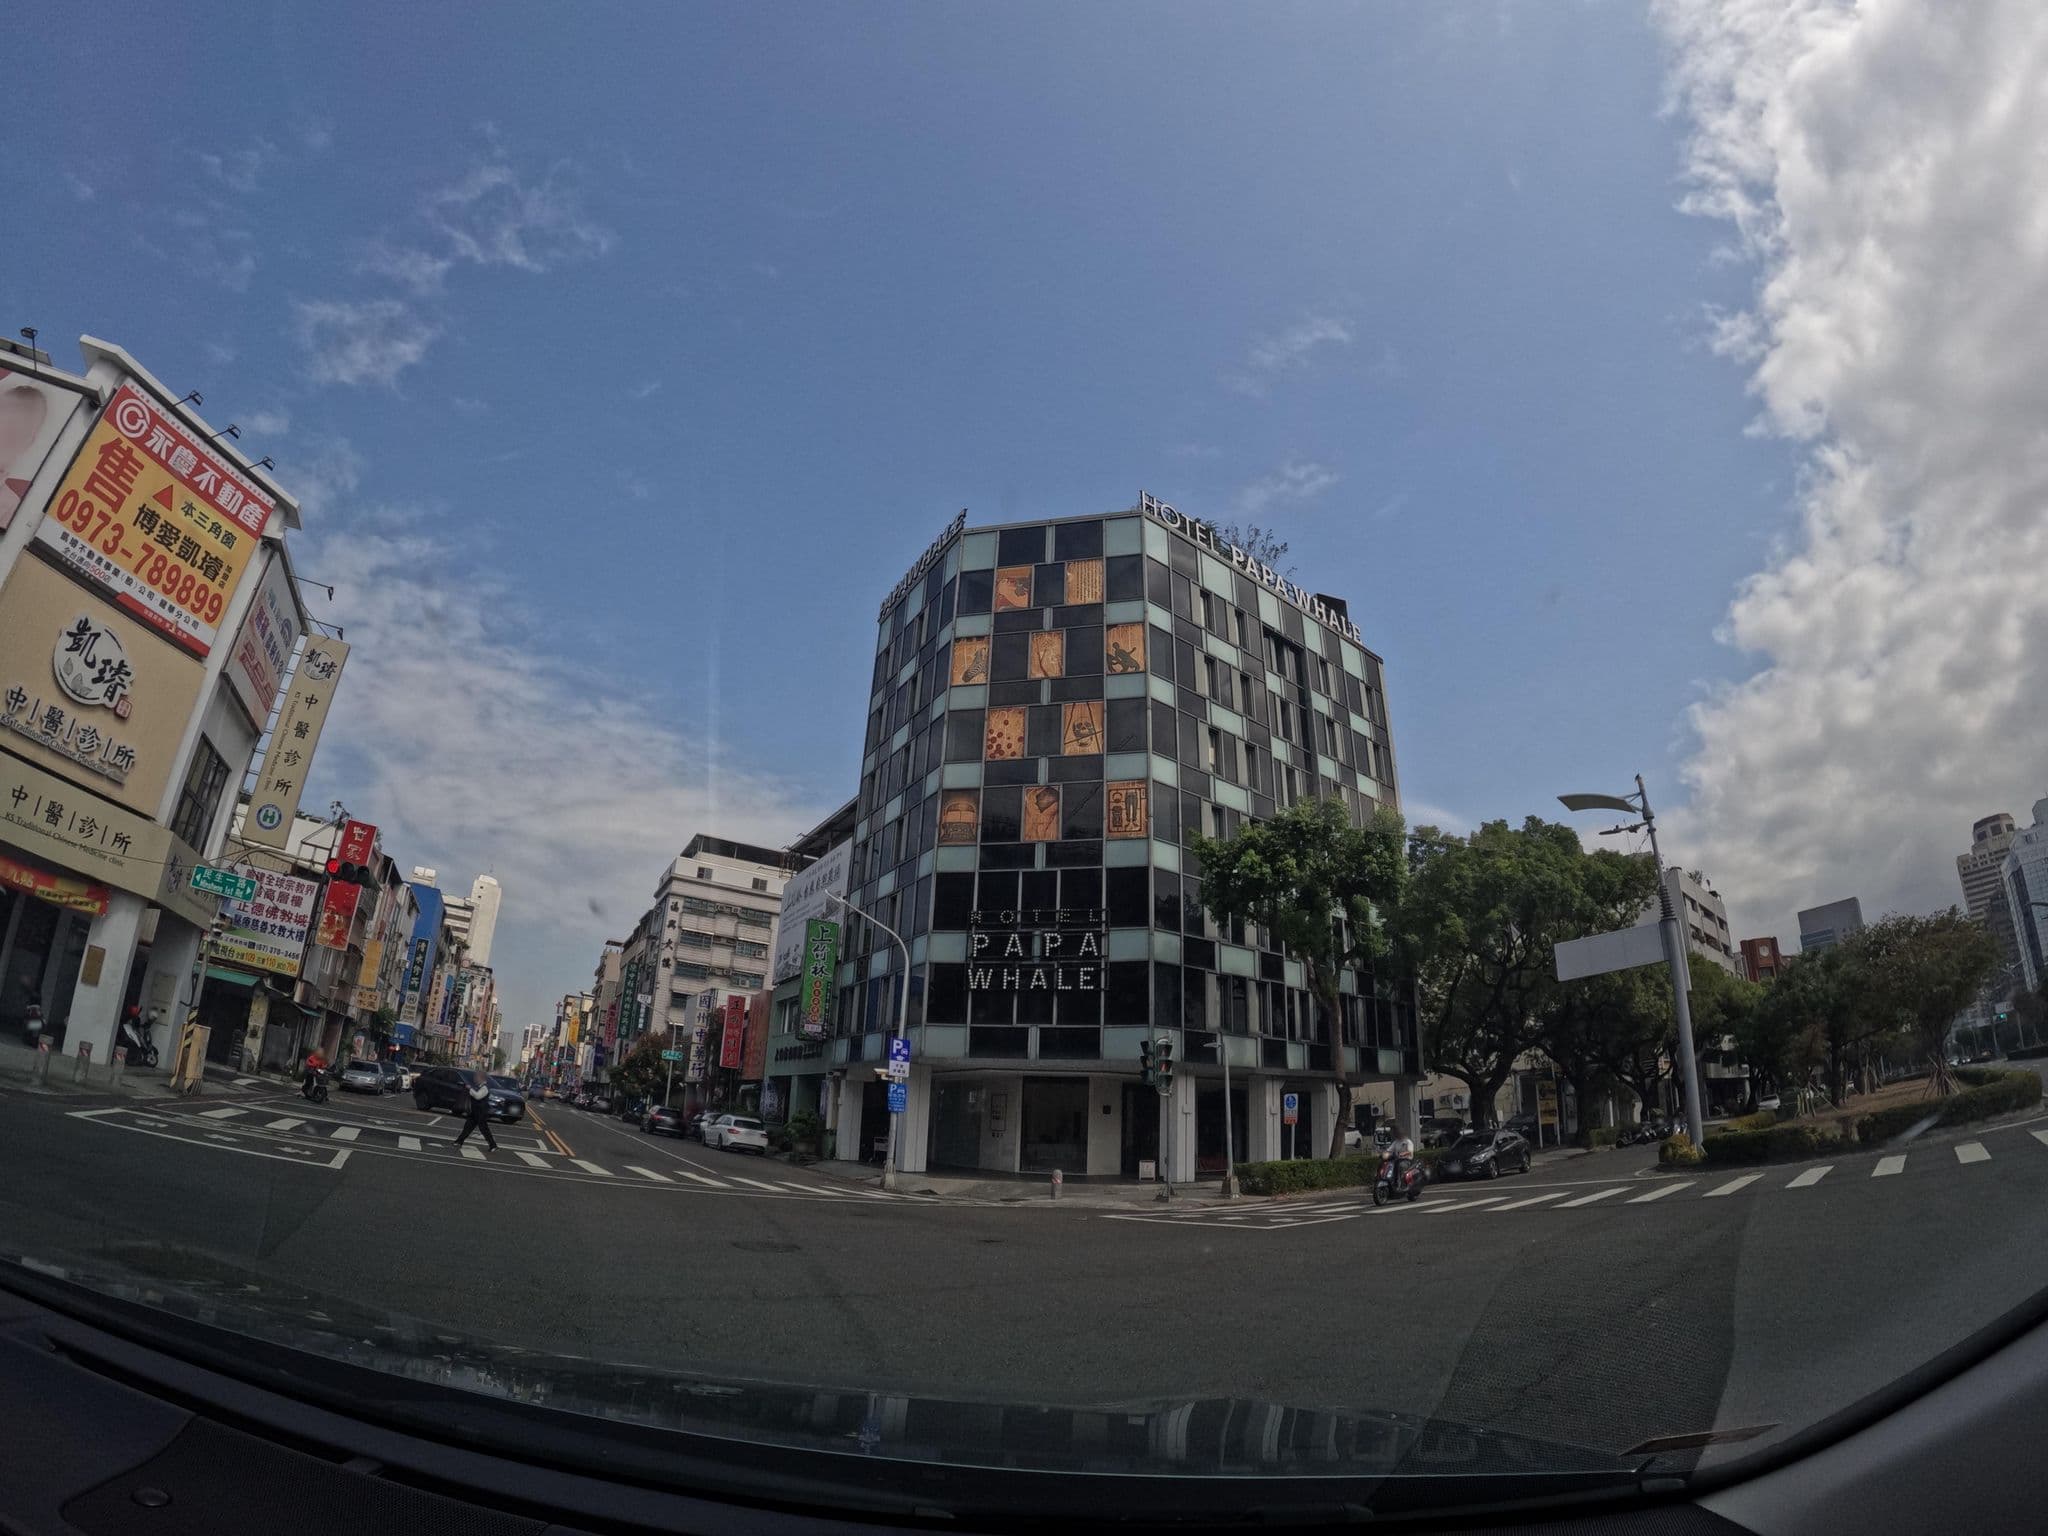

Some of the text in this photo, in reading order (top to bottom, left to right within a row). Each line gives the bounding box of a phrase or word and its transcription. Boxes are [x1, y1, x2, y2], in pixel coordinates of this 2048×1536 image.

[84, 437, 145, 514] 售
[144, 427, 265, 531] 永慶不動產
[56, 489, 224, 624] 0973-789899
[132, 503, 224, 583] 博愛凱璿
[1140, 490, 1364, 644] HOTEL PAPA WHALE
[64, 616, 134, 702] 凱璿
[305, 648, 338, 679] 凱璿
[273, 693, 319, 797] 中醫診所
[17, 815, 53, 836] Traditional
[202, 868, 247, 890] 民生一路
[970, 907, 1100, 925] HOTEL
[971, 932, 1098, 958] PAPA
[811, 924, 833, 979] 上竹林
[967, 967, 1094, 990] WHALE
